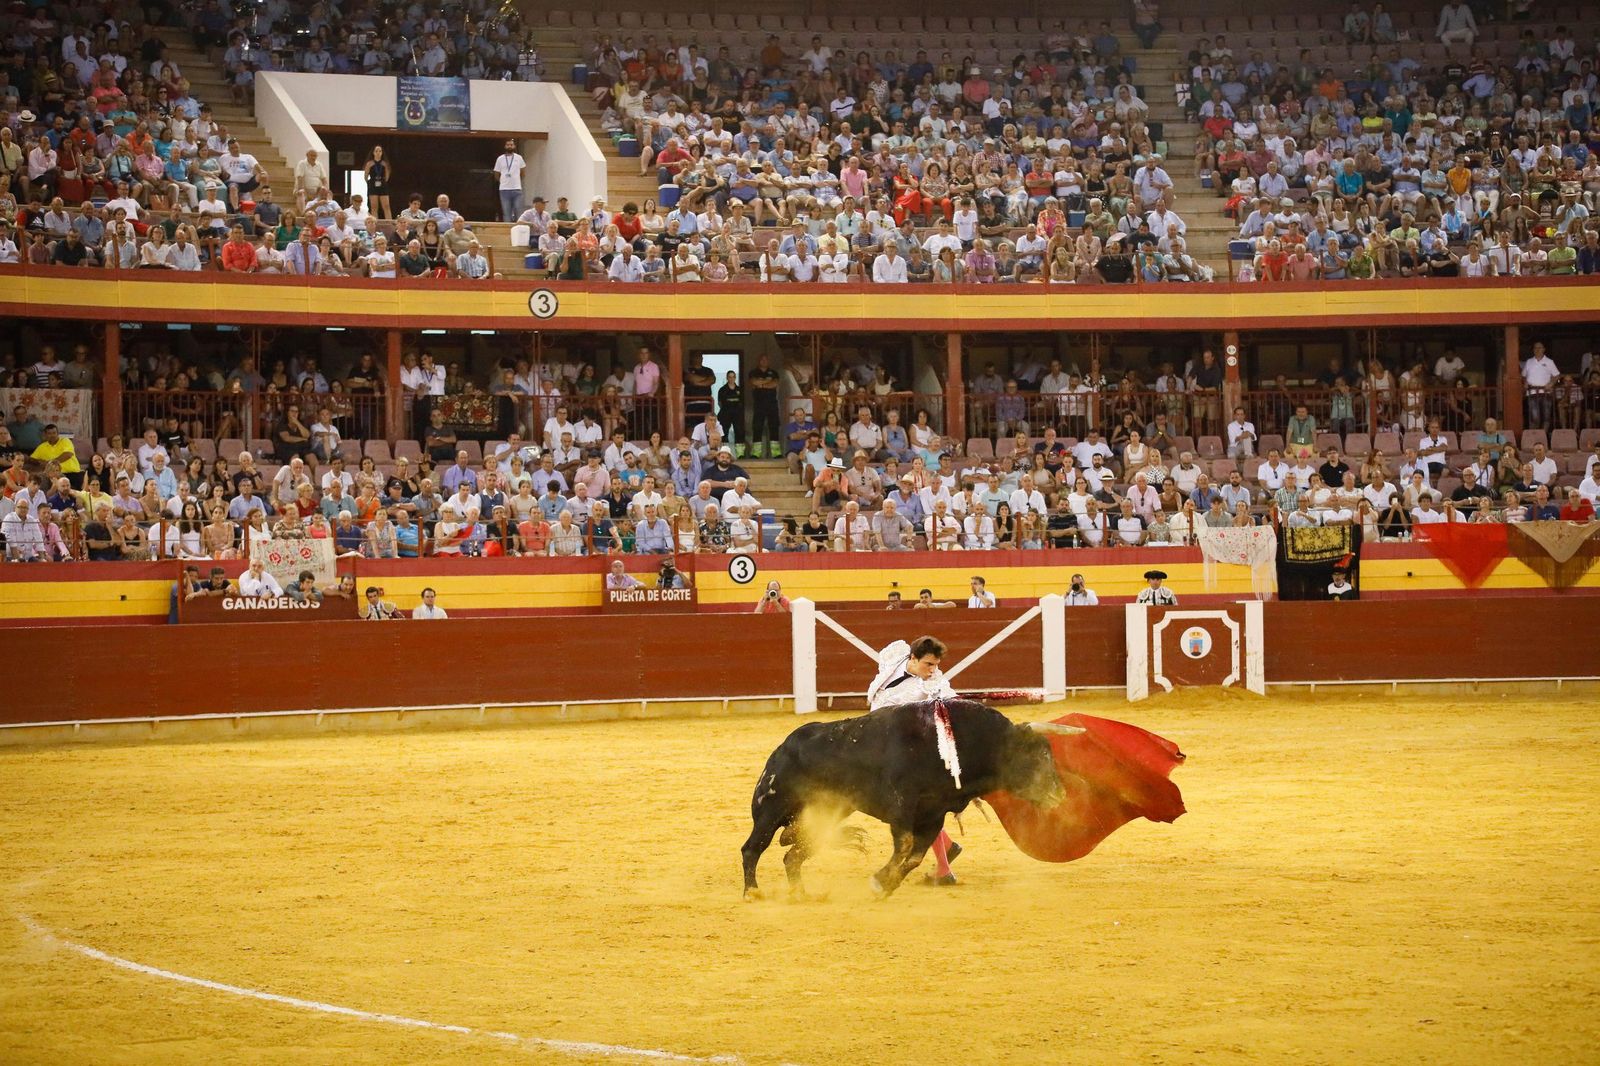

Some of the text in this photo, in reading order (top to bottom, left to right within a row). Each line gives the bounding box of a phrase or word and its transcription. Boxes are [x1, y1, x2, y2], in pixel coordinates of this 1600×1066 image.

[538, 294, 550, 314] 3
[737, 560, 748, 579] 3
[222, 597, 320, 610] GANADEROS
[610, 589, 691, 603] PUERTA DE CORTE
